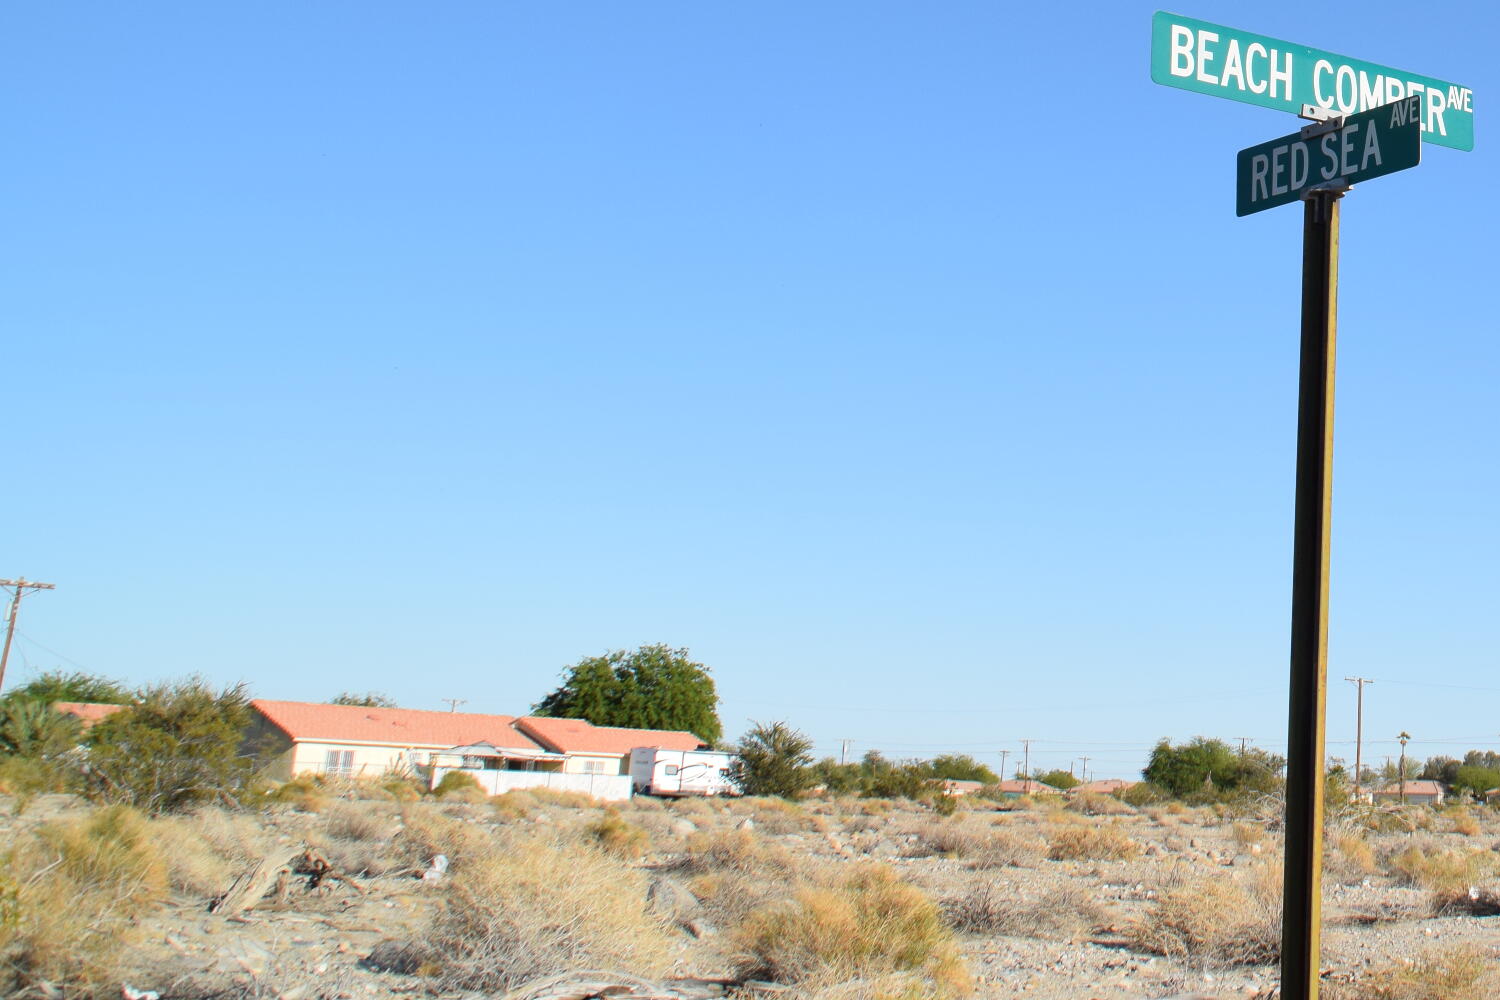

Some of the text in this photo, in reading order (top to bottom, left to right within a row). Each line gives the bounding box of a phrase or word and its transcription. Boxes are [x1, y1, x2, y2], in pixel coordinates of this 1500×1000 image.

[1170, 24, 1293, 101] BEACH
[1447, 86, 1473, 113] AVE
[1251, 97, 1418, 203] RED SEA AVE
